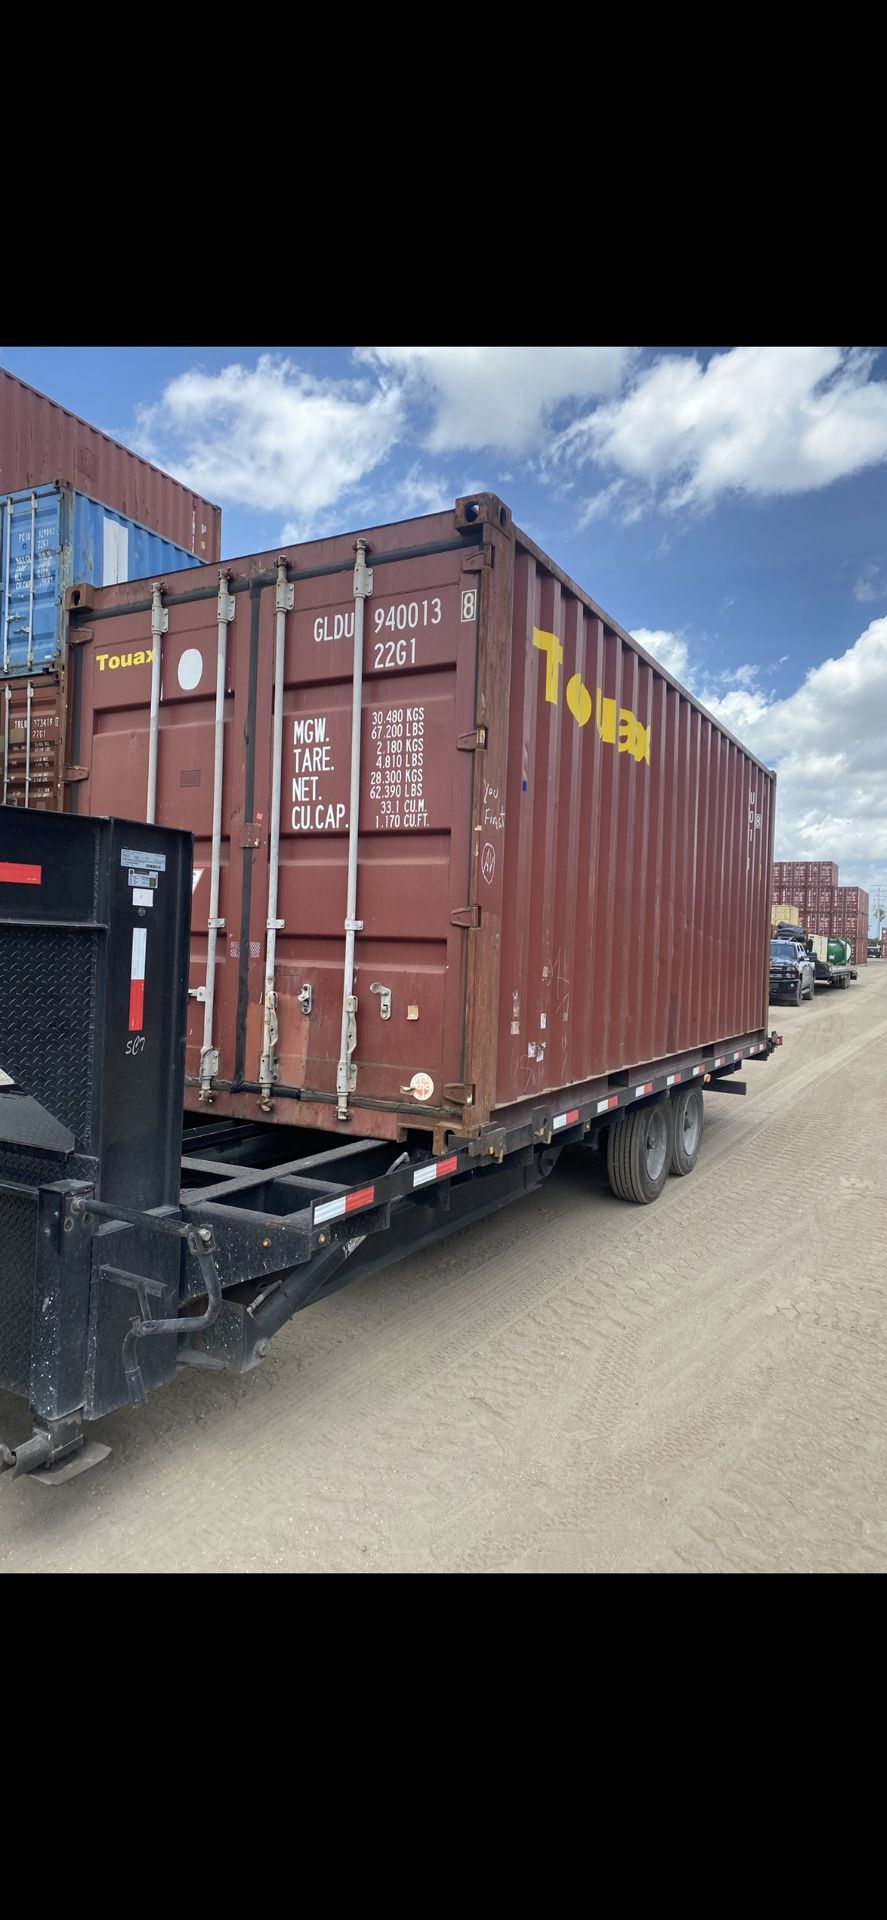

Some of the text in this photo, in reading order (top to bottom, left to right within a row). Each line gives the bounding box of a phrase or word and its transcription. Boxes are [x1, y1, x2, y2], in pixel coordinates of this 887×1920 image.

[314, 591, 476, 642] GLDU 940013 8
[96, 649, 155, 671] Touax
[374, 638, 416, 669] 22G1
[293, 707, 425, 745] MGW. 30.480 KGS
[371, 722, 425, 739] 67.200 LBS
[293, 738, 424, 773] TARE. 2.180 KGS
[375, 752, 424, 769] 4.810 LBS
[292, 768, 423, 802] NET. 28.300 KGS
[370, 783, 423, 800] 62.390 LBS
[292, 804, 349, 830] CU.CAP.
[380, 800, 399, 814] 33.1
[375, 815, 400, 829] 1.170
